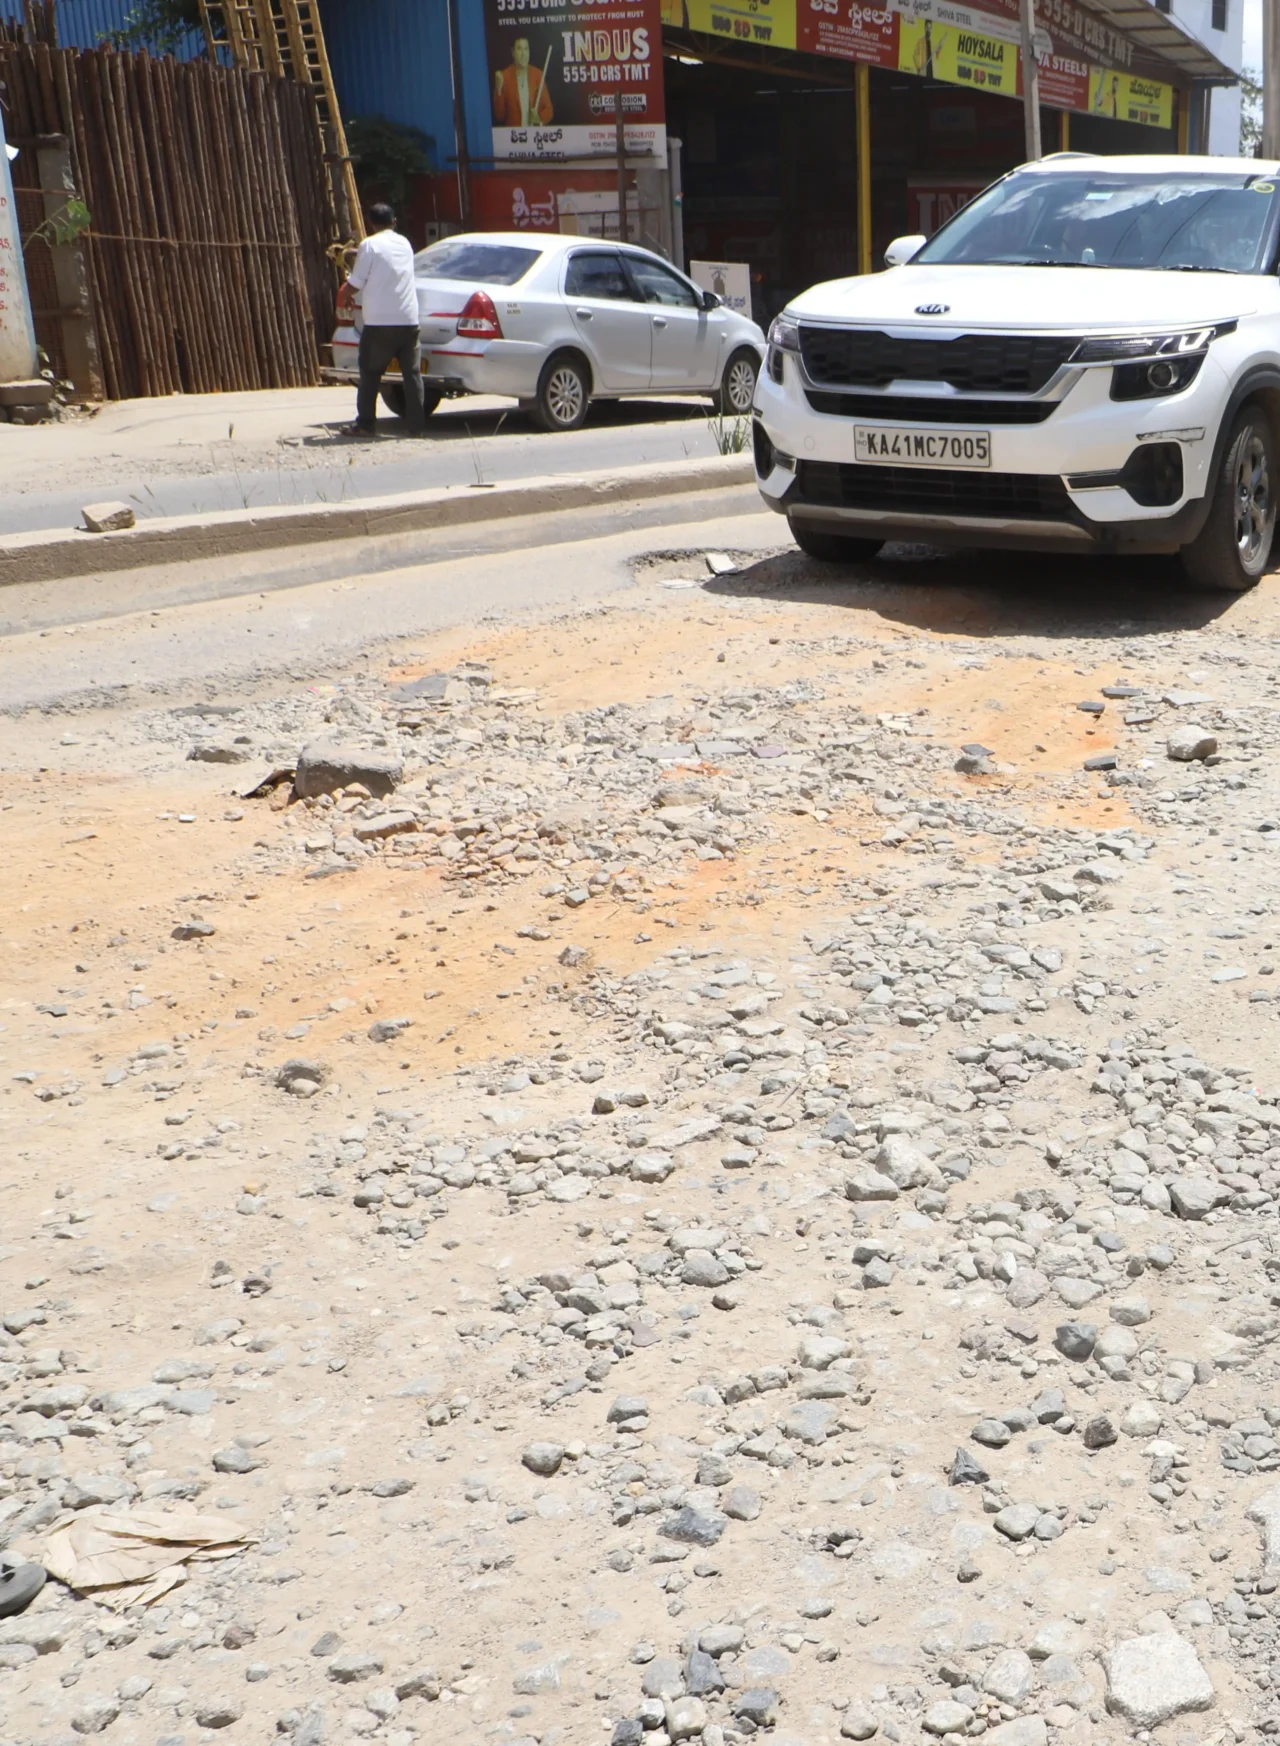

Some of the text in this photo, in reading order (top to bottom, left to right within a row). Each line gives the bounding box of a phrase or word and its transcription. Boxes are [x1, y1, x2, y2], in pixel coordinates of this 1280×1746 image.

[498, 10, 644, 26] STEEL YOU CAN TRUST TO PROTECT FROM RUST
[937, 7, 954, 20] SHIVA
[955, 10, 973, 26] STEEL
[561, 27, 650, 62] INDUS
[957, 34, 1004, 63] HOYSALA
[1084, 17, 1105, 50] CRS
[1107, 30, 1134, 68] TMT
[563, 63, 650, 83] 555-D CRS TMT
[1052, 56, 1087, 77] STEELS
[604, 95, 643, 105] COOSION
[917, 304, 946, 313] KIA
[867, 433, 987, 459] KA41MC7005
